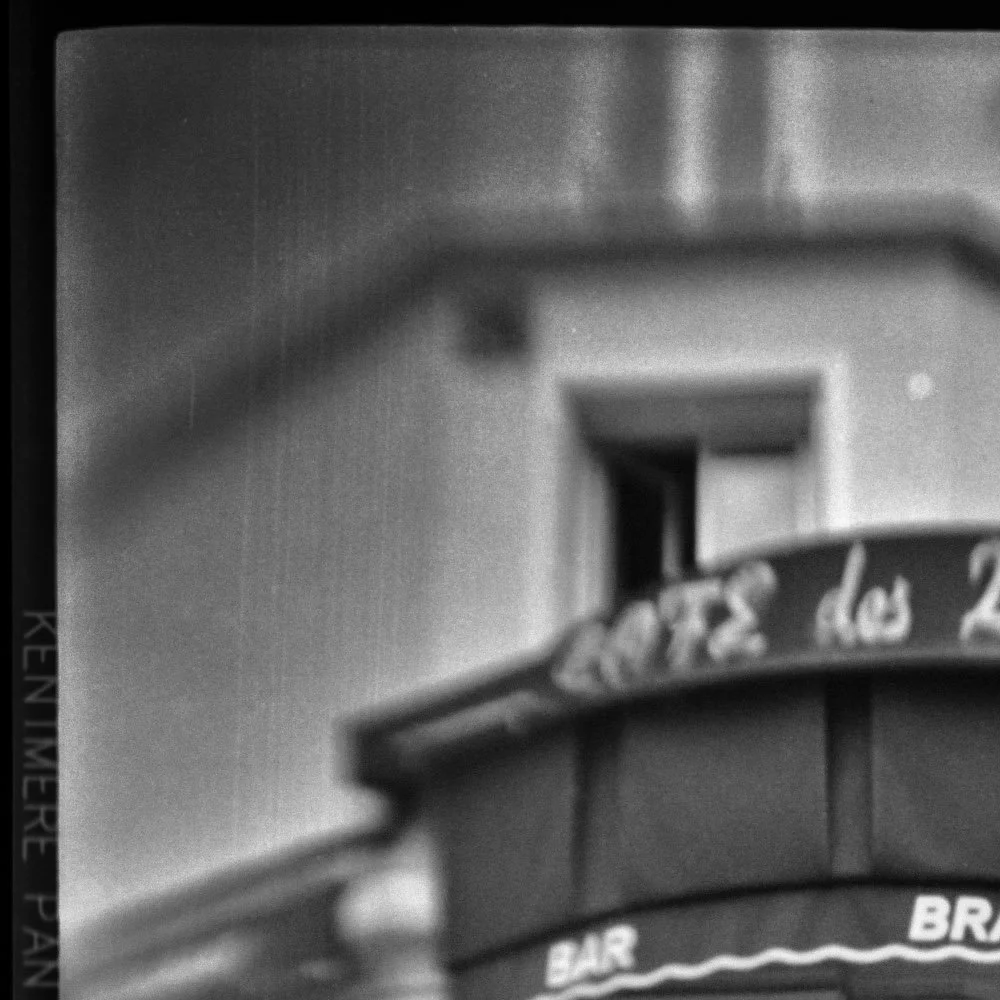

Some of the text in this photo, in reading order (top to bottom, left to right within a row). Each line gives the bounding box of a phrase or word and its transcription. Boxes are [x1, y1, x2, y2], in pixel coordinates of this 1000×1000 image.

[815, 540, 912, 646] des
[22, 892, 58, 987] PAN
[545, 924, 638, 988] BAR
